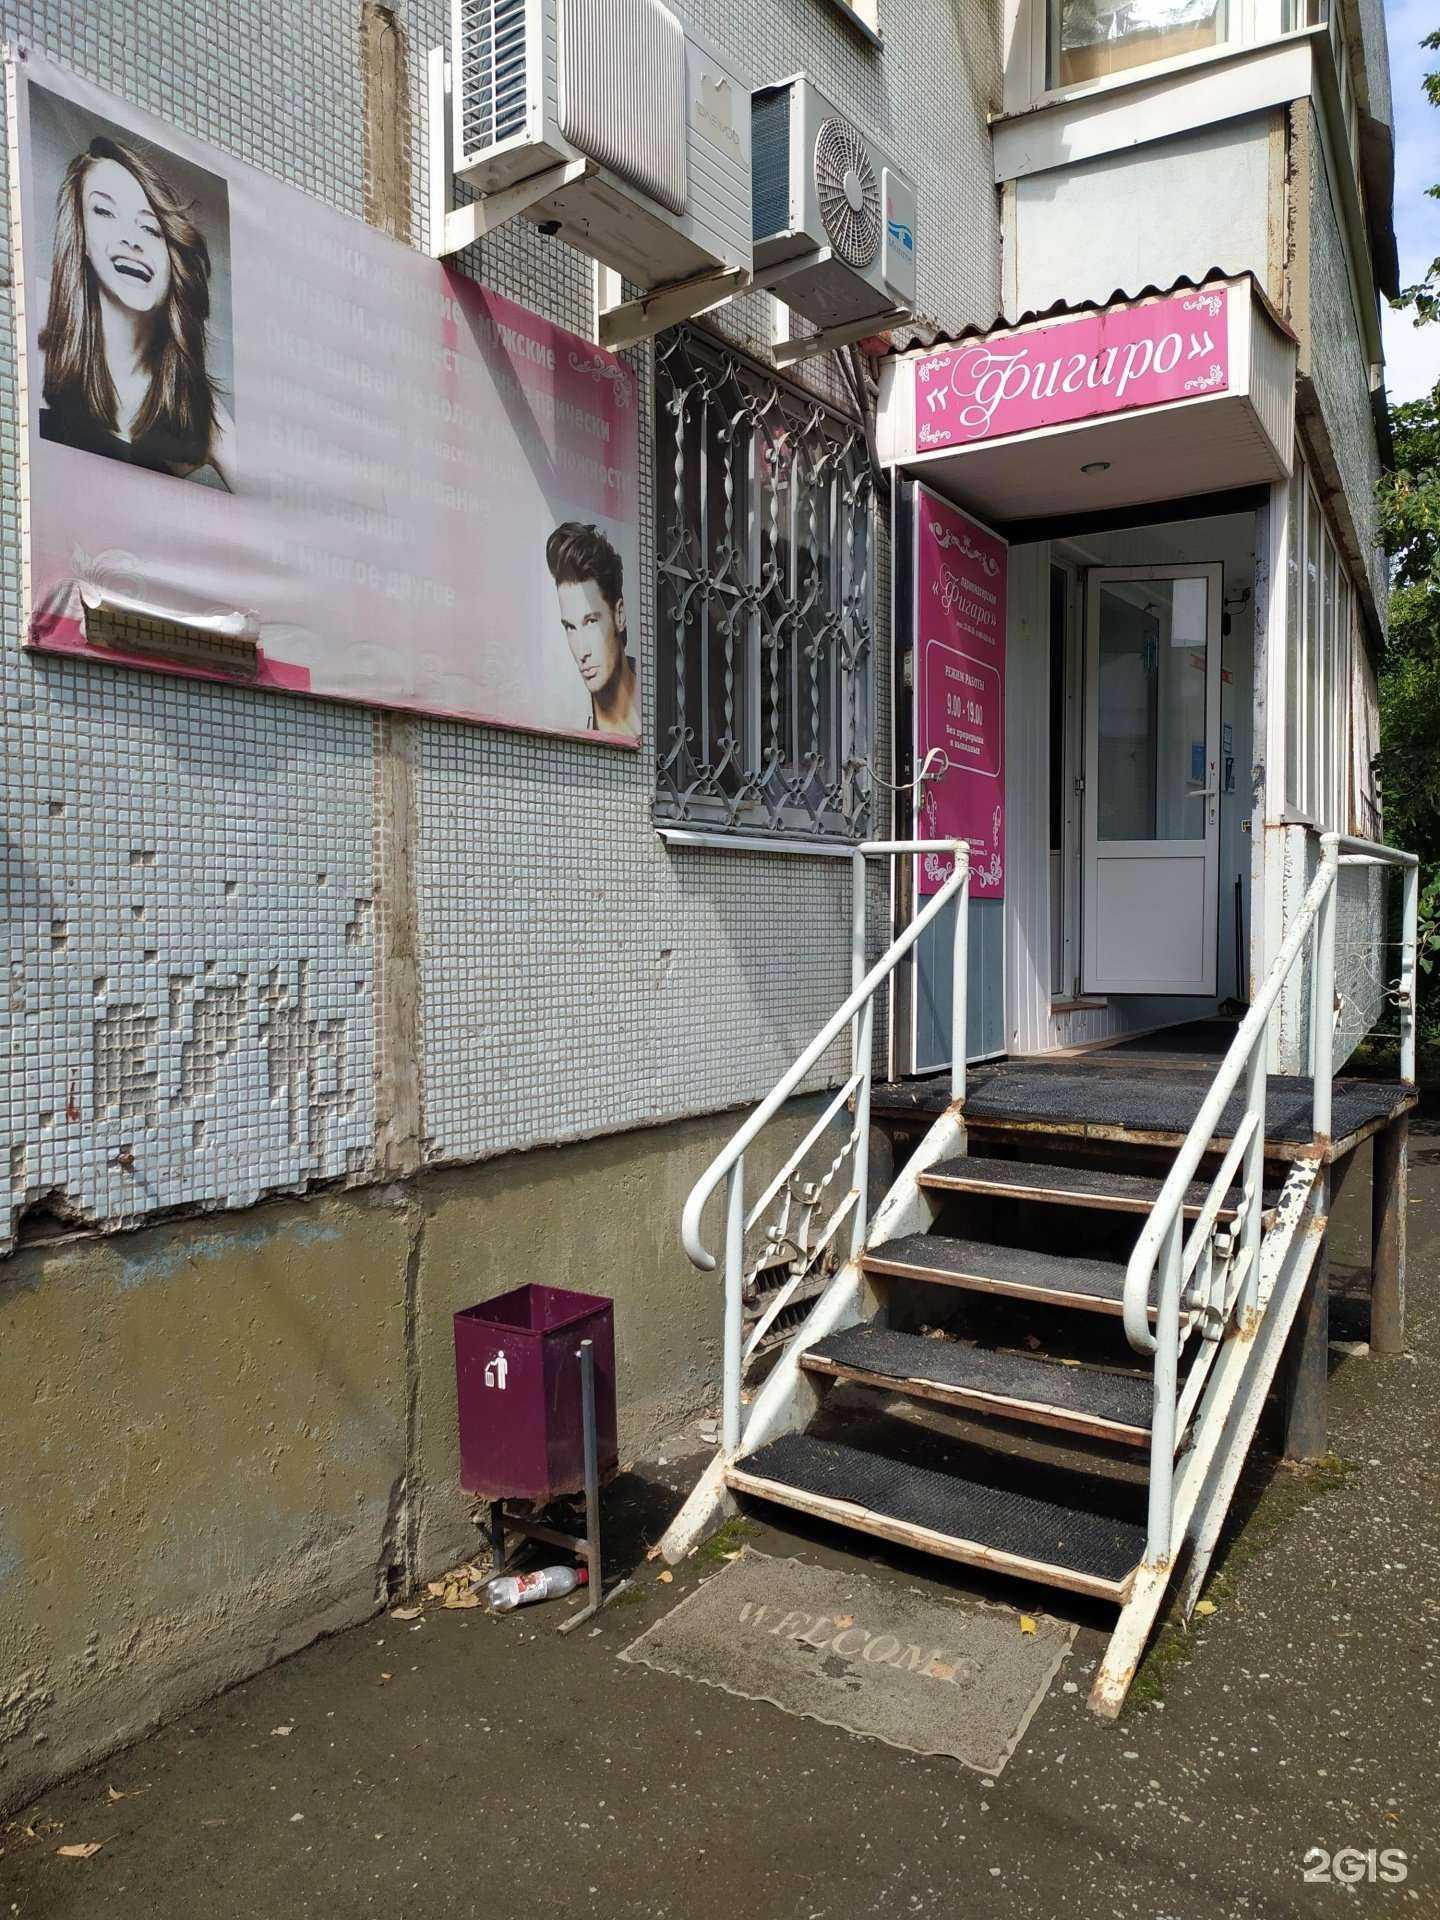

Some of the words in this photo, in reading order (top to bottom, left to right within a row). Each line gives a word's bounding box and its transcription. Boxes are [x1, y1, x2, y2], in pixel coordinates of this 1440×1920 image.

[944, 665, 965, 682] РЕЖИМ
[964, 674, 985, 691] РАБОТЫ
[946, 692, 962, 718] 9.00
[966, 699, 984, 726] 19.00
